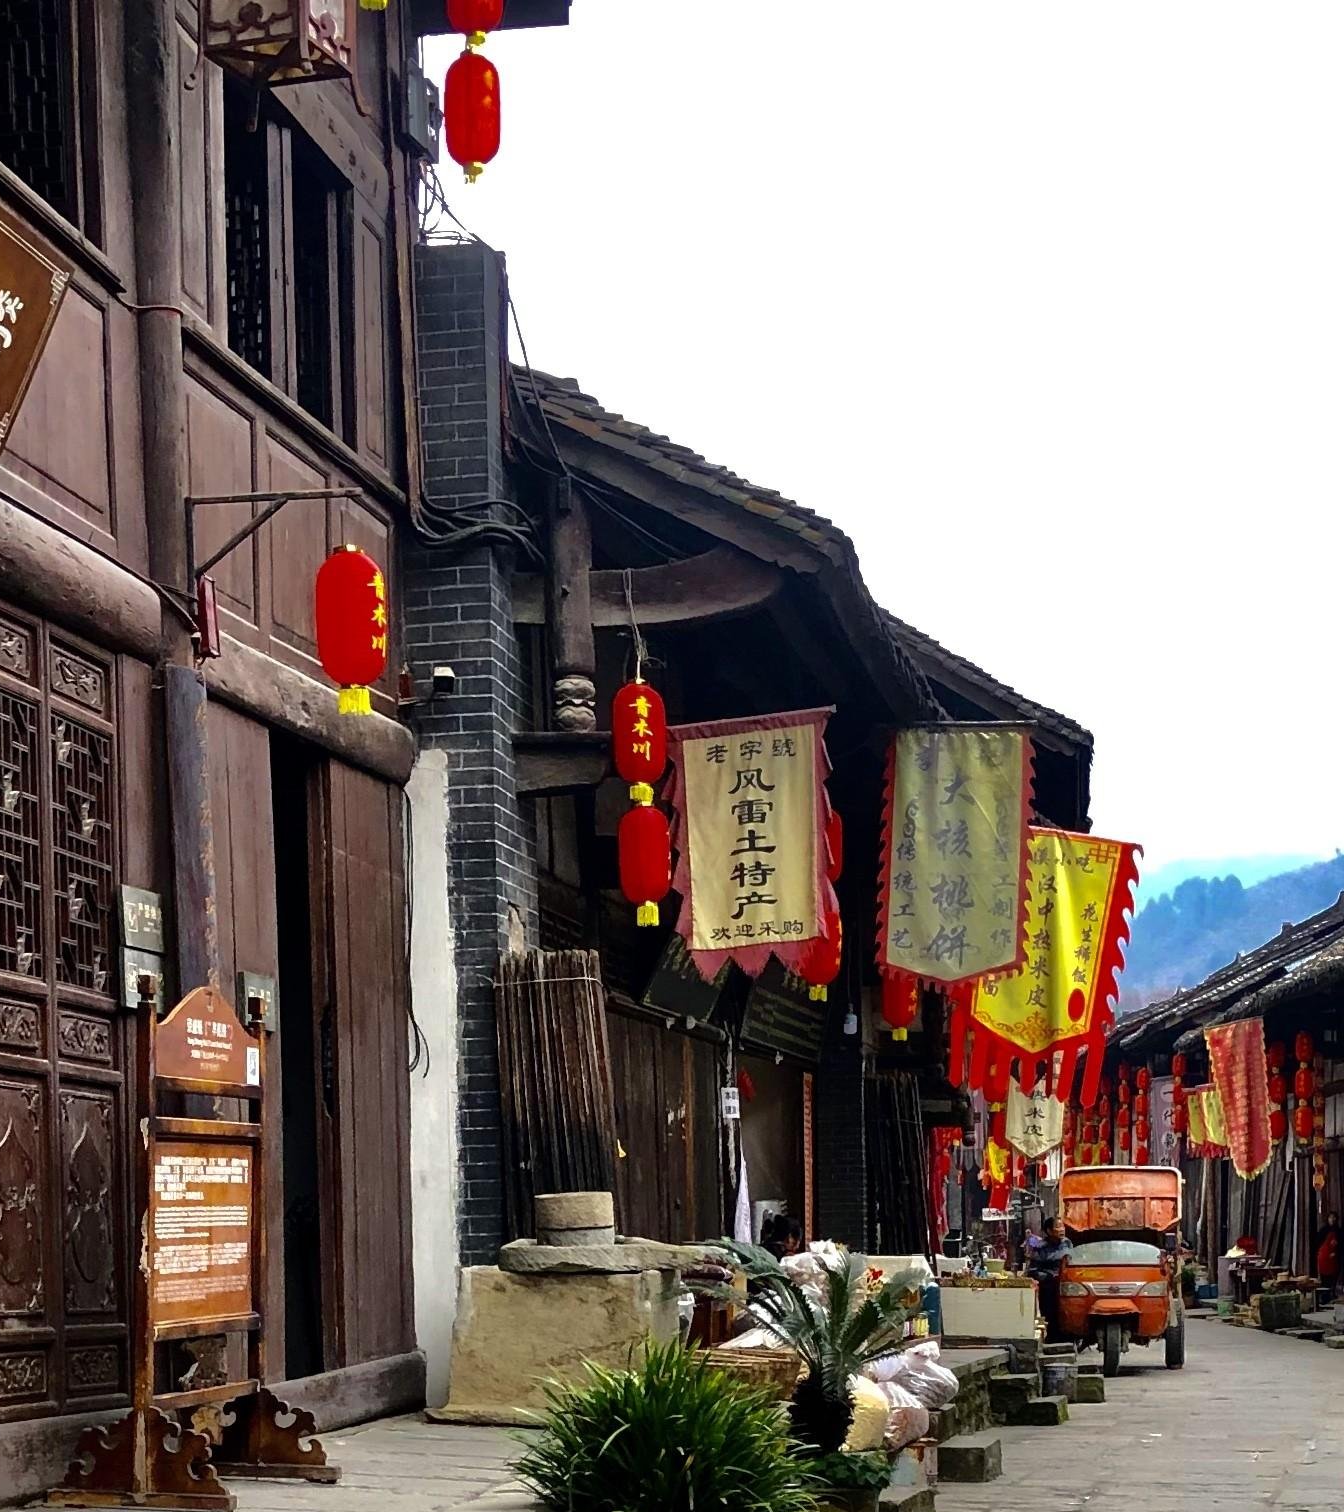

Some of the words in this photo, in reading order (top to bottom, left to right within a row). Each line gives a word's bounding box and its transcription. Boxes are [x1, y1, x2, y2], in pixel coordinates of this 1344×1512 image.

[367, 570, 387, 658] 青木川
[628, 695, 654, 761] 青木川
[727, 767, 778, 921] 风雷土特产
[711, 920, 805, 941] 欢迎采购
[1026, 874, 1058, 1008] 汉中热米皮
